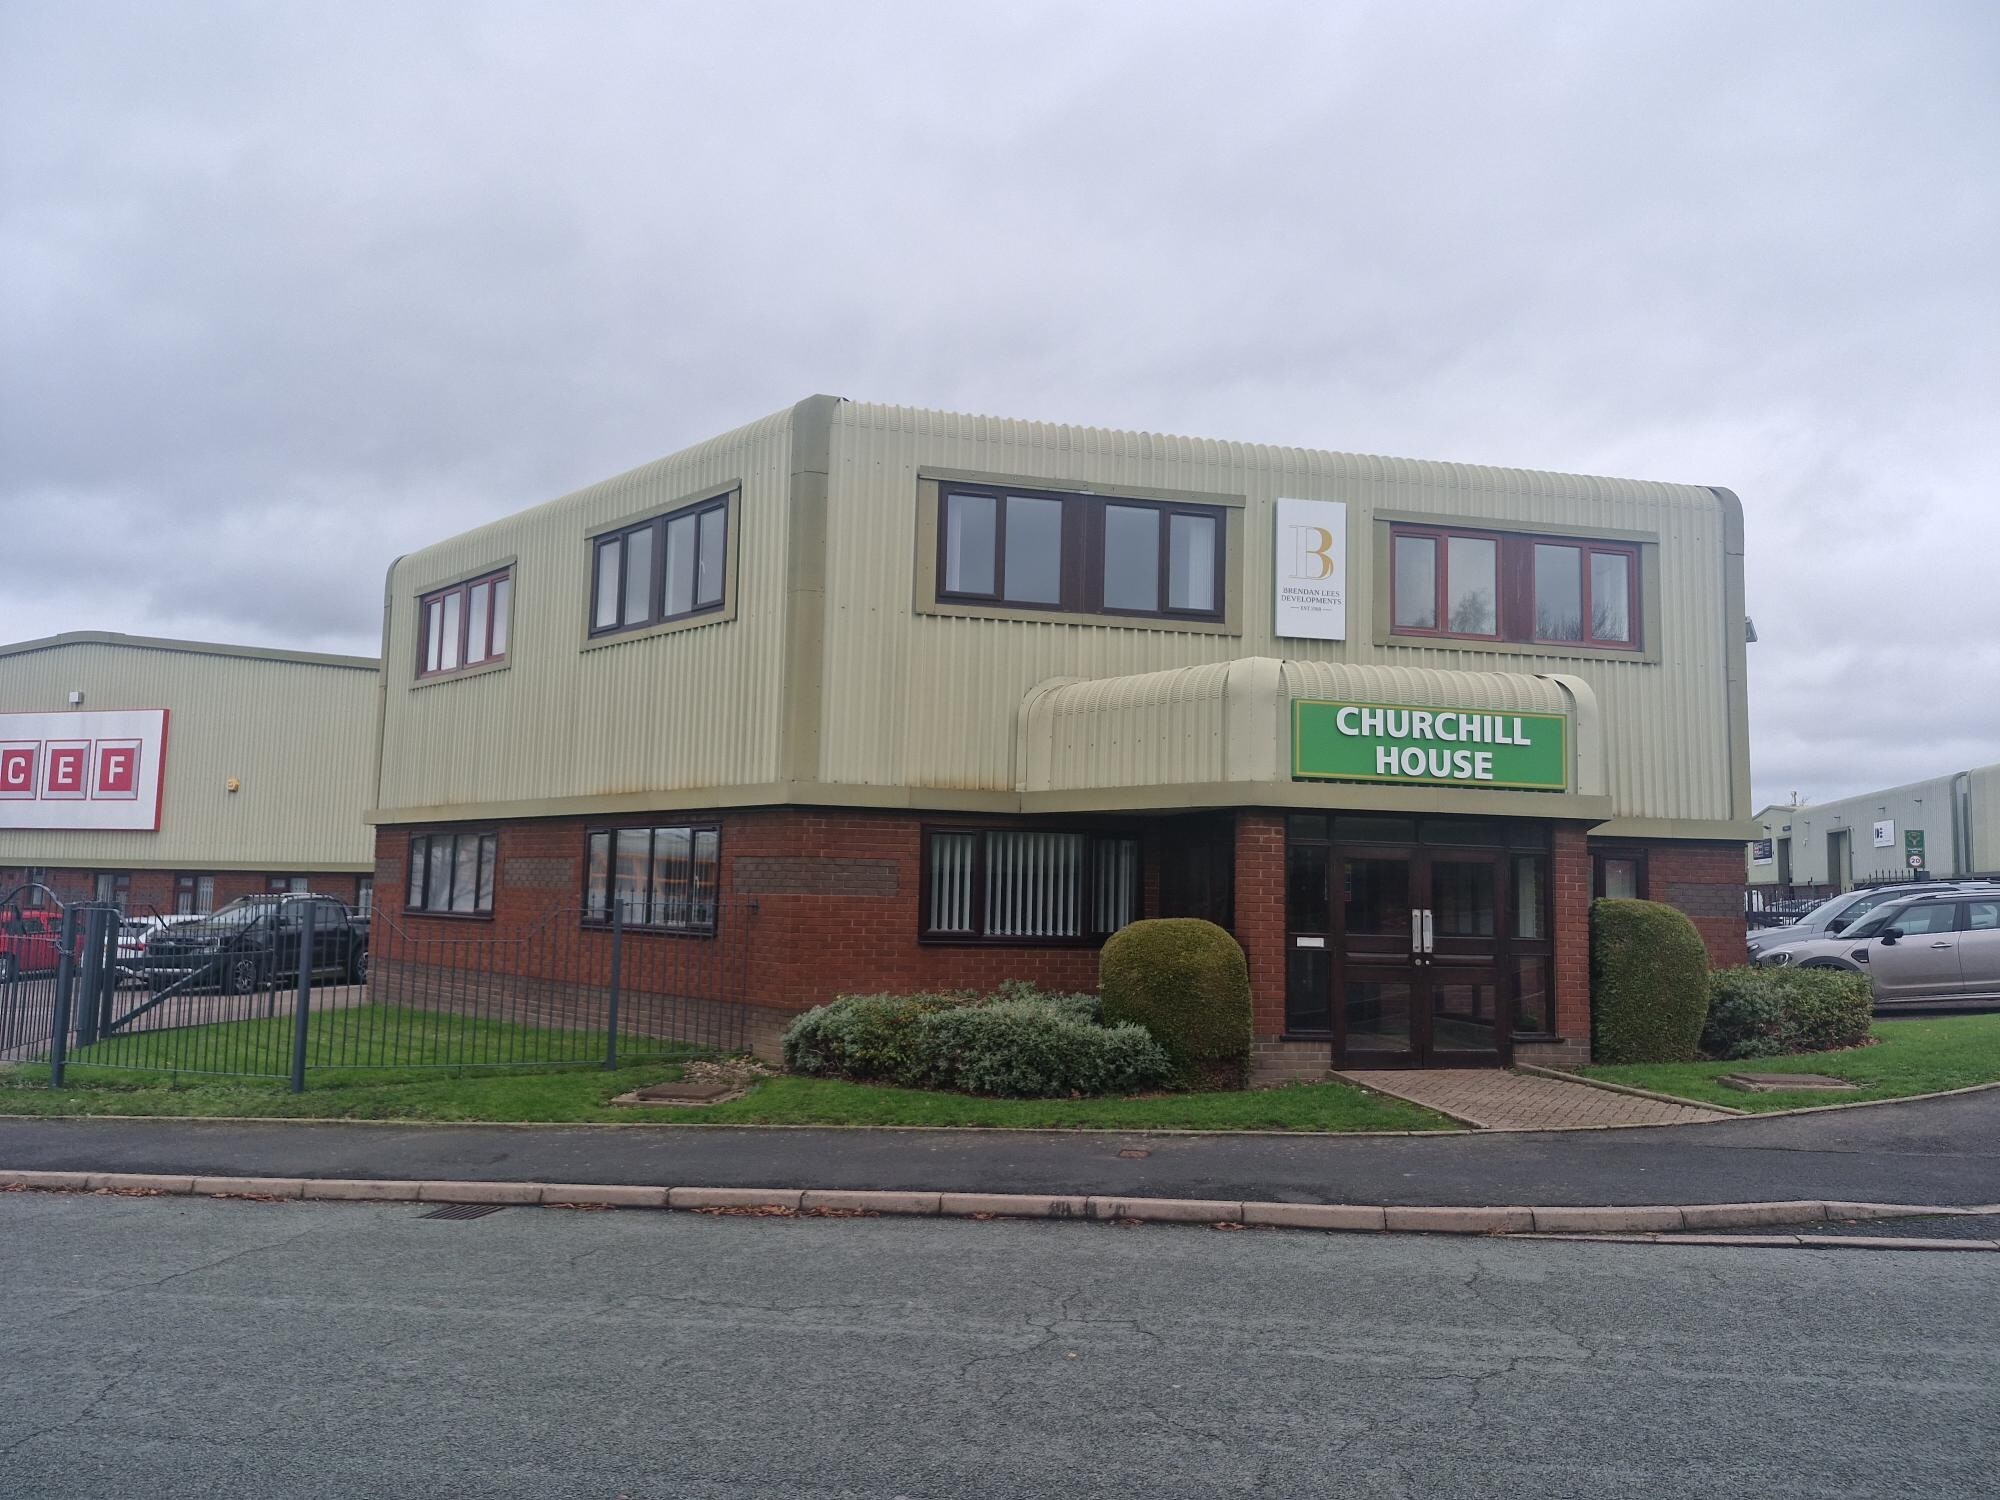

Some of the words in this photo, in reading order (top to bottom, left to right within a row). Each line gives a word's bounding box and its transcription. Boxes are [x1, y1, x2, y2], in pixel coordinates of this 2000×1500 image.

[1281, 595, 1342, 605] DEVELOPMENTS
[1282, 587, 1320, 596] BRENDAN
[1321, 590, 1340, 598] LEES
[1336, 706, 1531, 746] CHURCHILL
[8, 756, 125, 784] CEF
[1376, 745, 1493, 780] HOUSE
